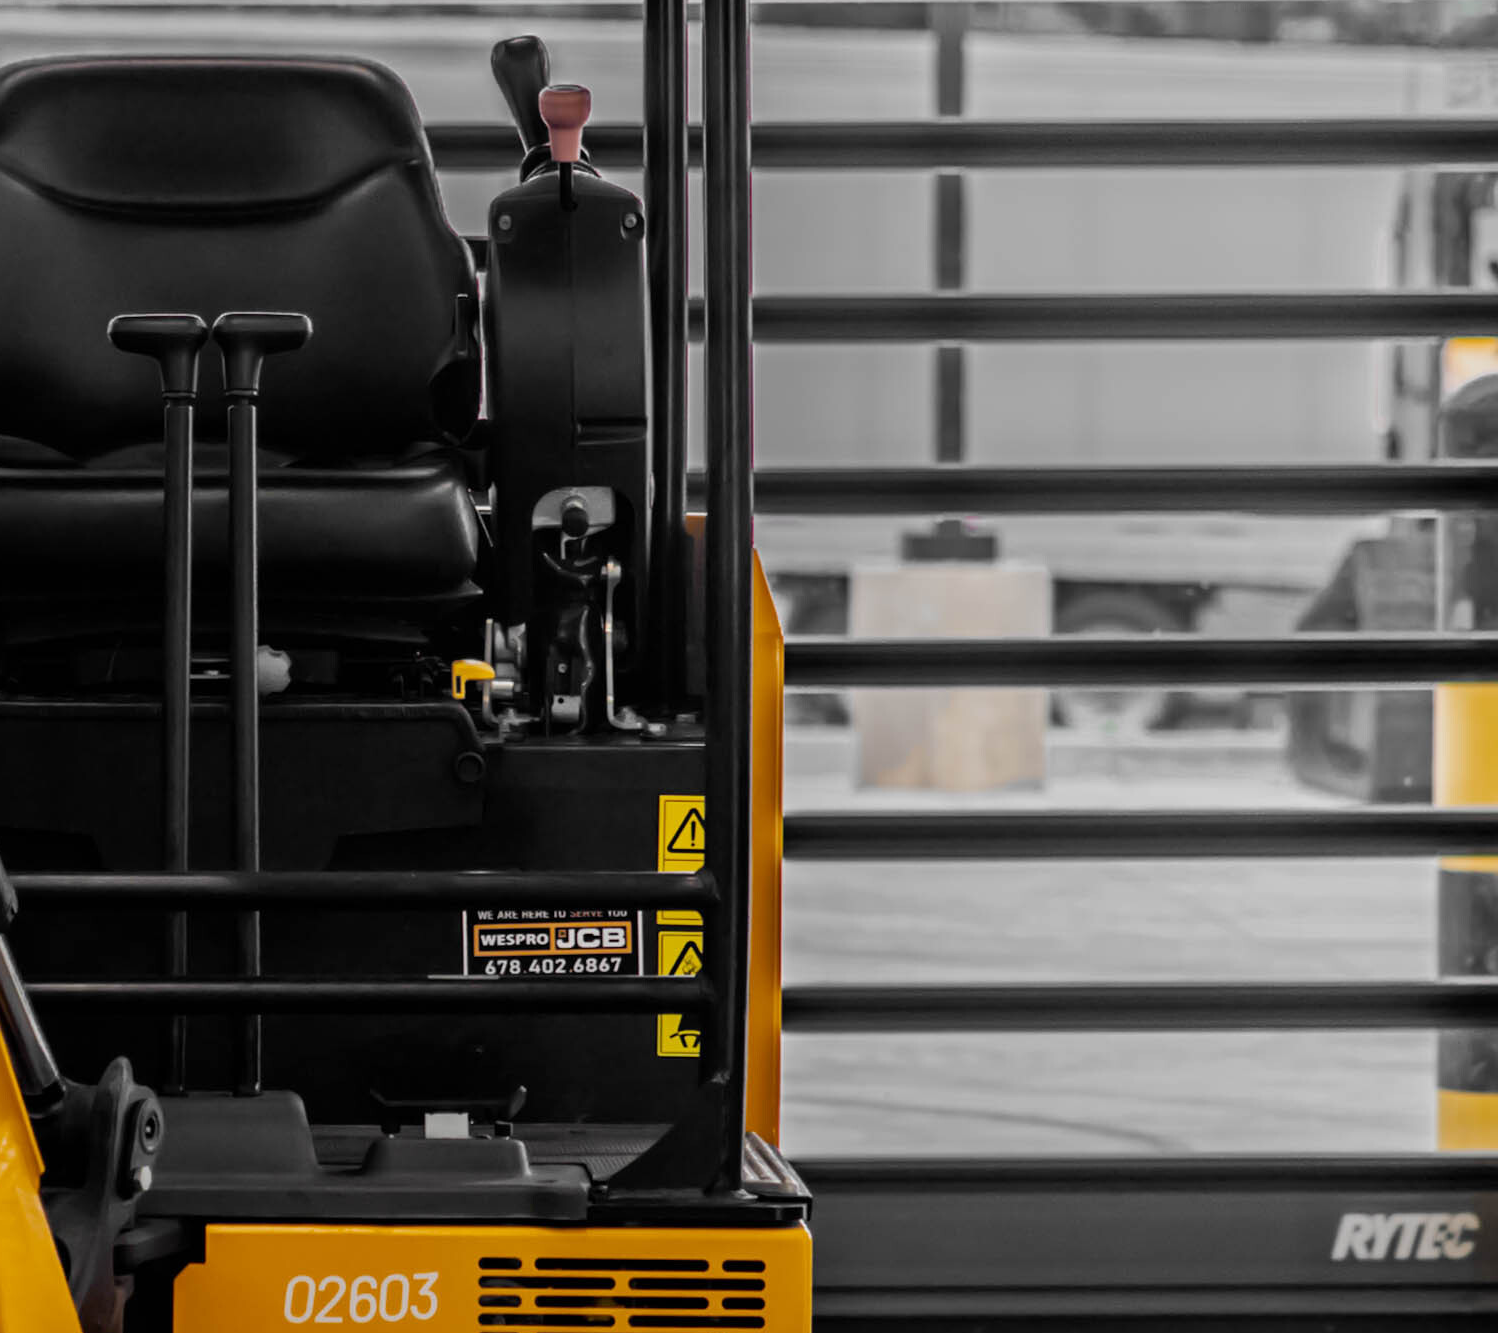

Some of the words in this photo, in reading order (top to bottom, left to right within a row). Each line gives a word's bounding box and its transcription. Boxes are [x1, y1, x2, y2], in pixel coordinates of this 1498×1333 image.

[477, 910, 494, 920] WE
[497, 910, 519, 920] ARE
[521, 910, 550, 919] HERE
[553, 910, 566, 918] TO
[570, 910, 603, 918] SERVE
[480, 933, 550, 947] WESPRO
[556, 928, 626, 949] JCB
[484, 957, 622, 975] 678.402.6867
[1331, 1212, 1480, 1260] RYTEC
[284, 1271, 440, 1324] 02603
